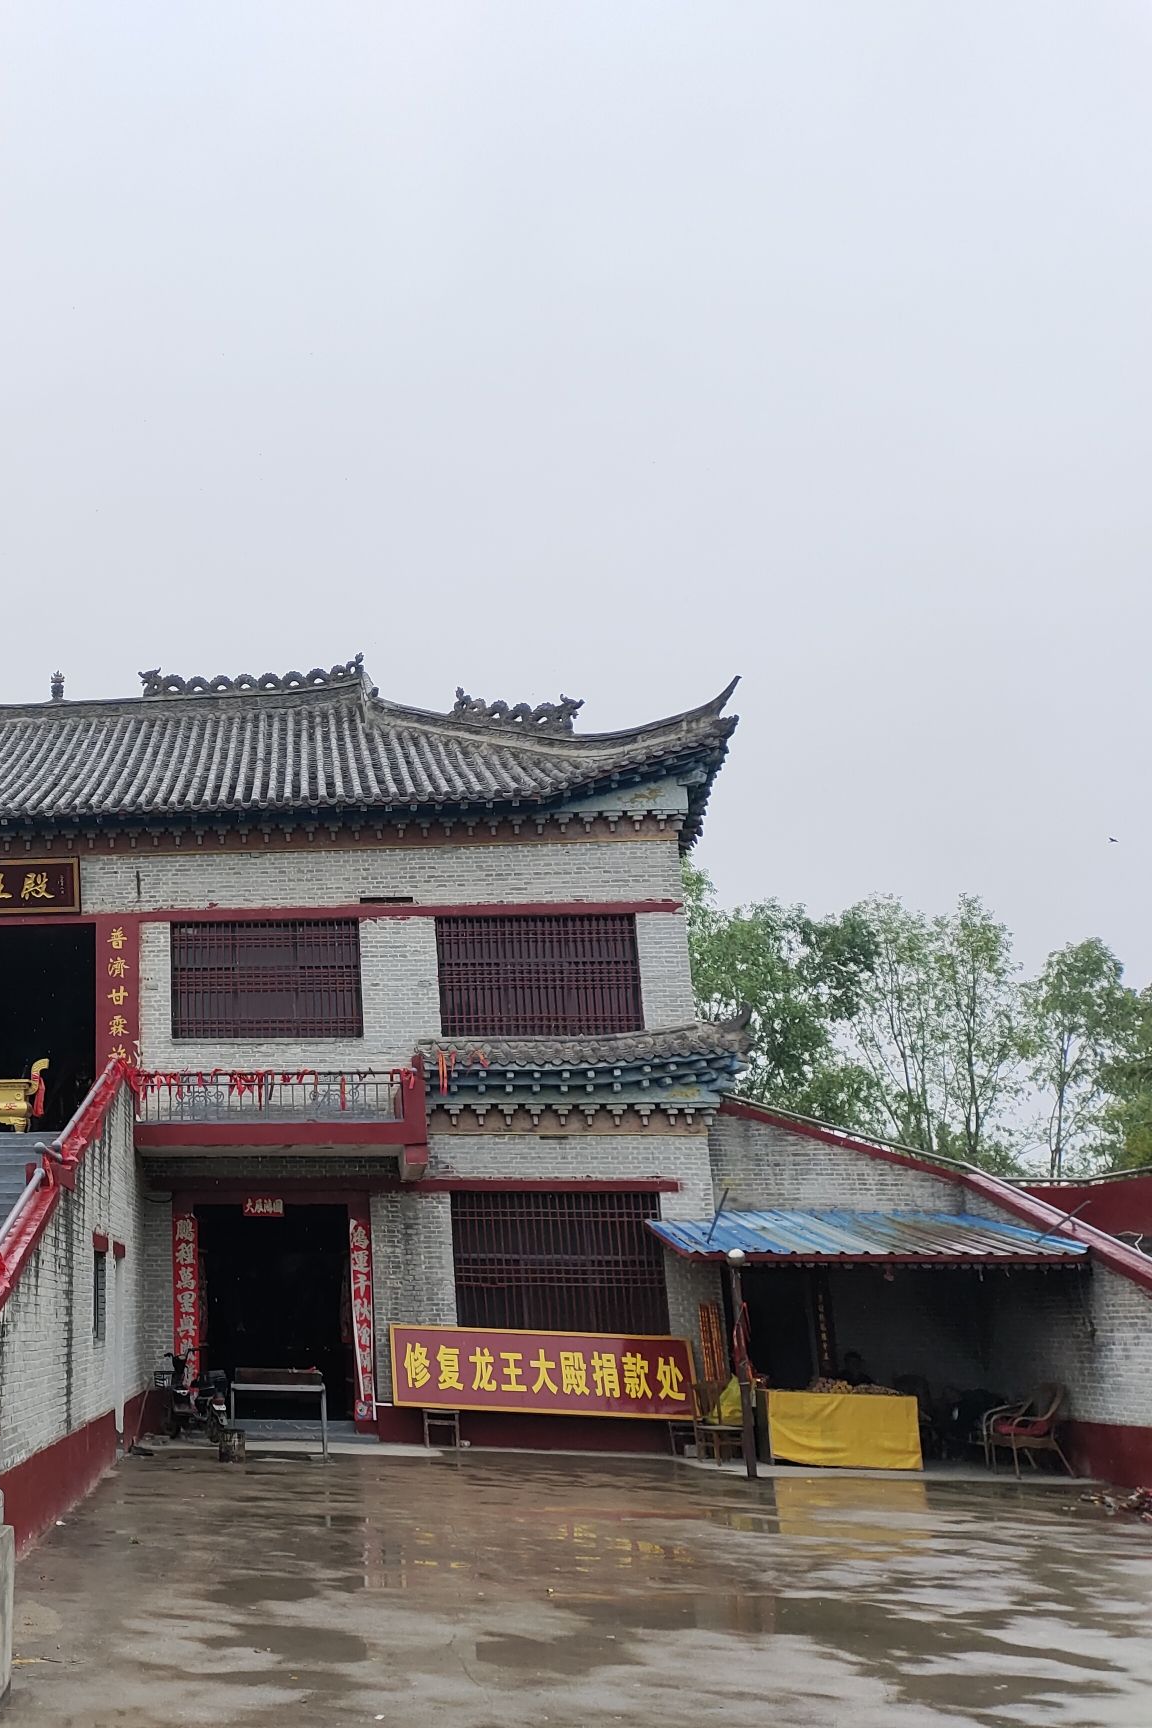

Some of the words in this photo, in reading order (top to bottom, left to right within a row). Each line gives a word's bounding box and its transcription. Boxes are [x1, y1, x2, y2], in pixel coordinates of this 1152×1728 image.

[403, 1341, 687, 1401] 修复龙王大殿捐款处
